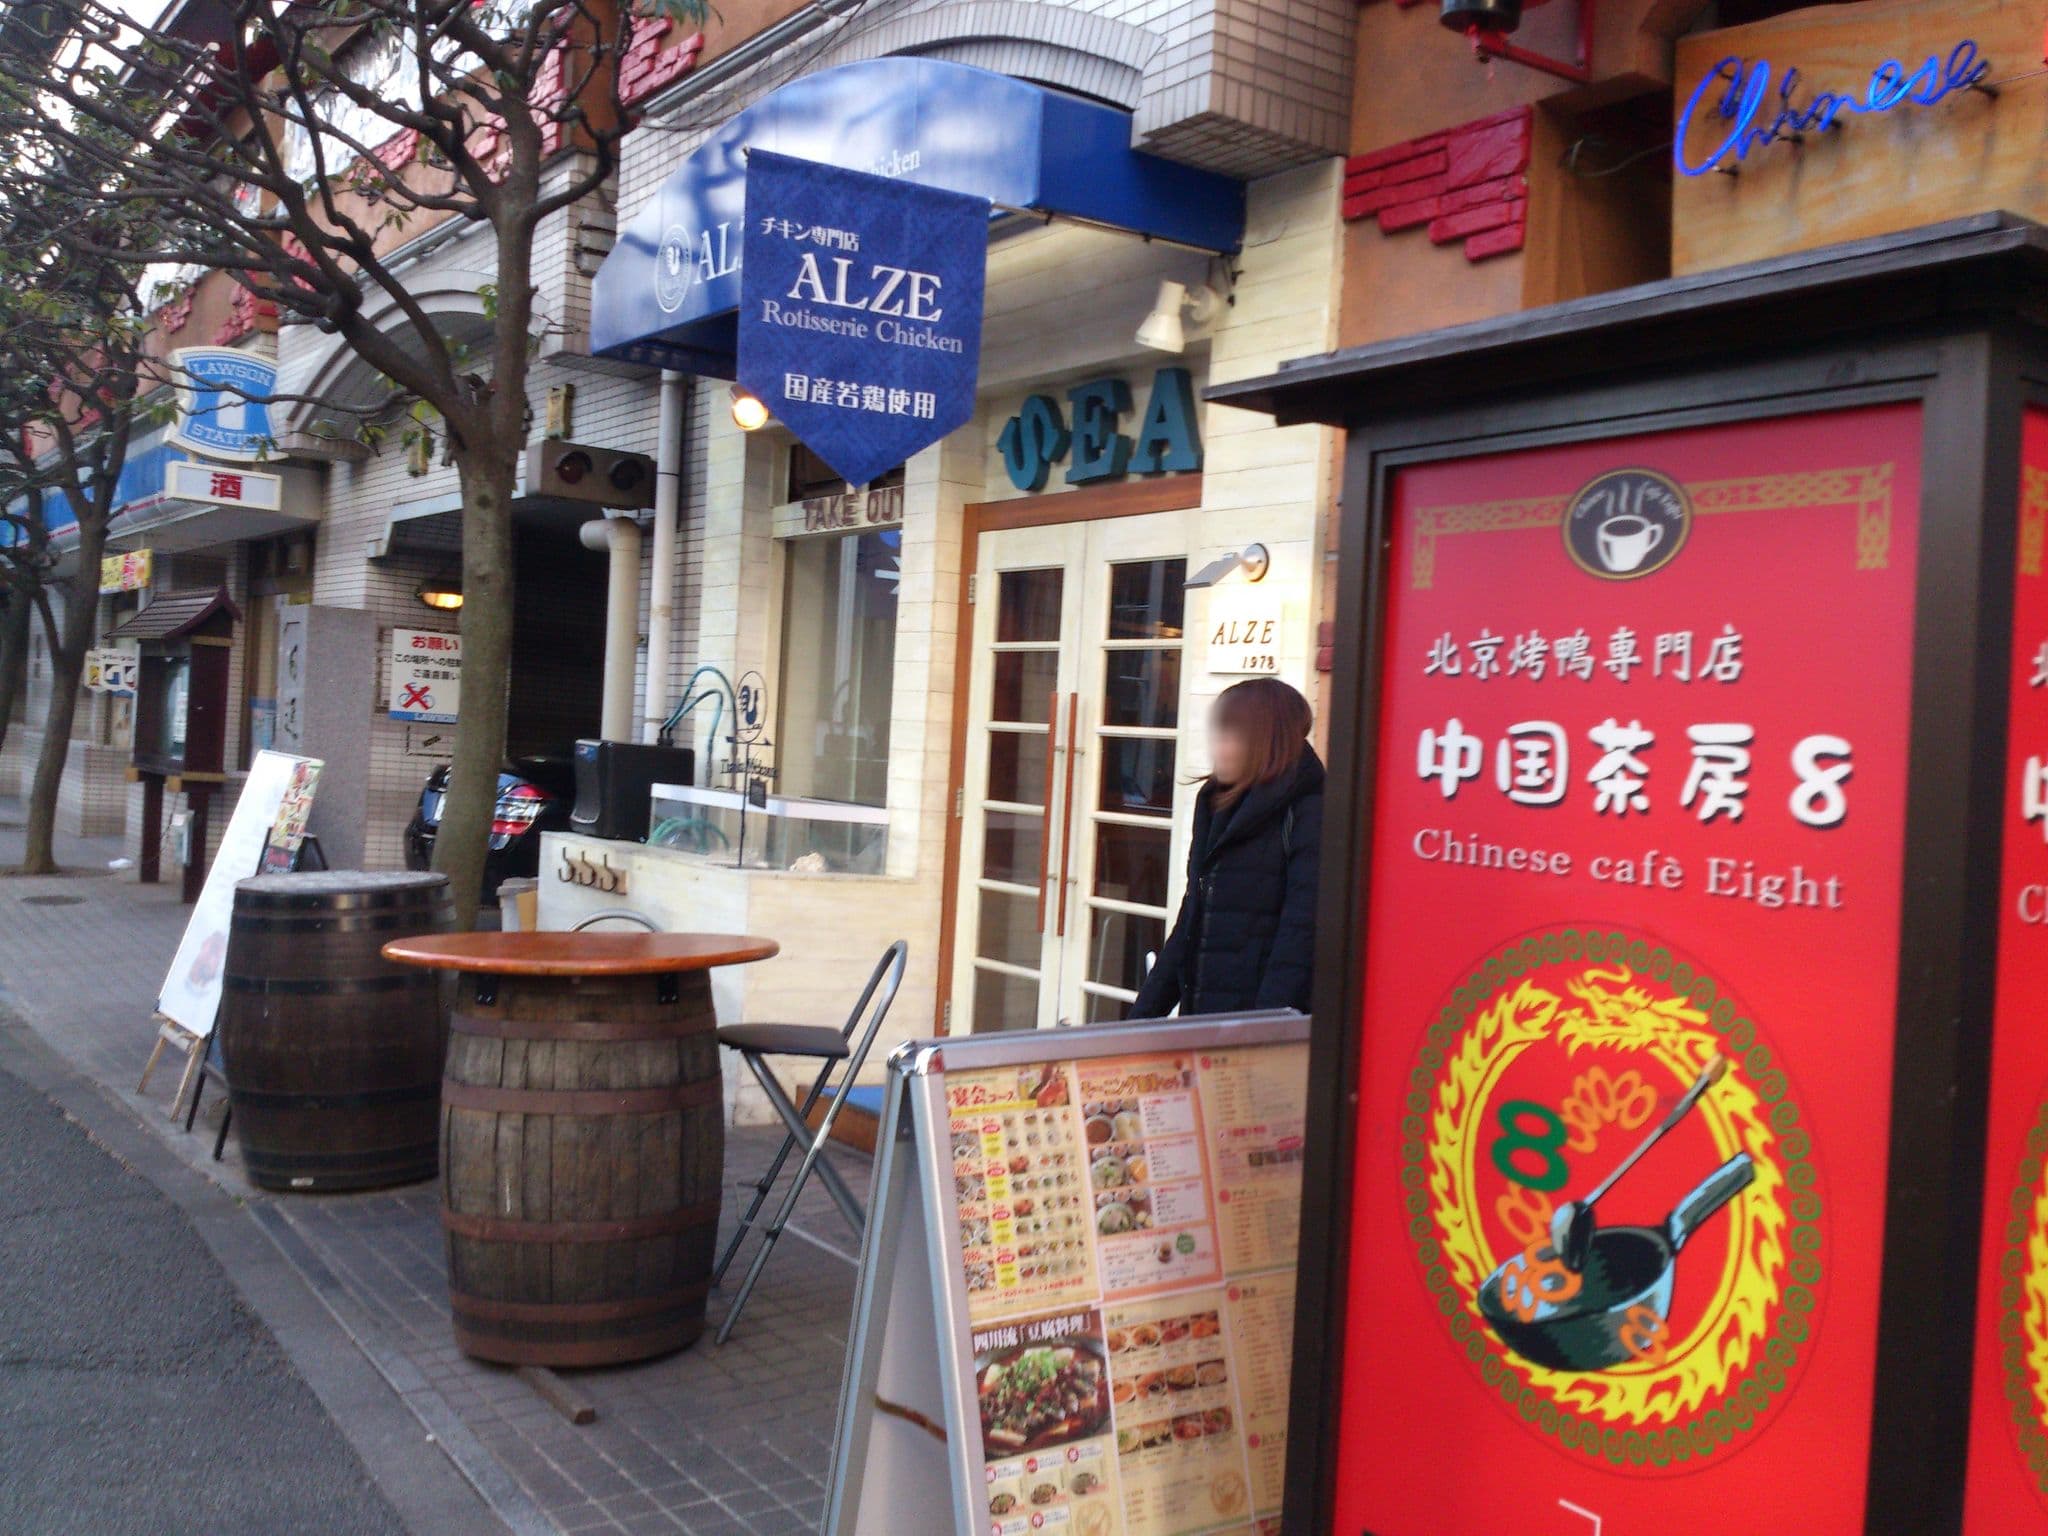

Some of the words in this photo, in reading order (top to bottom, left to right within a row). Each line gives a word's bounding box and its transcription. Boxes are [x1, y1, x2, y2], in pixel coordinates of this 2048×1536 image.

[1674, 39, 1988, 175] Chinese
[693, 216, 744, 285] AL
[761, 217, 859, 252] チキン専門店
[787, 253, 943, 322] ALZE
[761, 299, 869, 338] Rotisserie
[876, 320, 963, 354] Chicken
[192, 361, 273, 386] LAWSON
[784, 373, 936, 419] 国産若鶏使用
[996, 368, 1202, 491] SEA
[210, 473, 242, 500] 酒
[802, 494, 859, 531] TAKE
[1211, 621, 1275, 645] ALZE
[1242, 656, 1275, 669] 1978
[1413, 829, 1572, 876] Chinese
[1707, 858, 1844, 909] Eight
